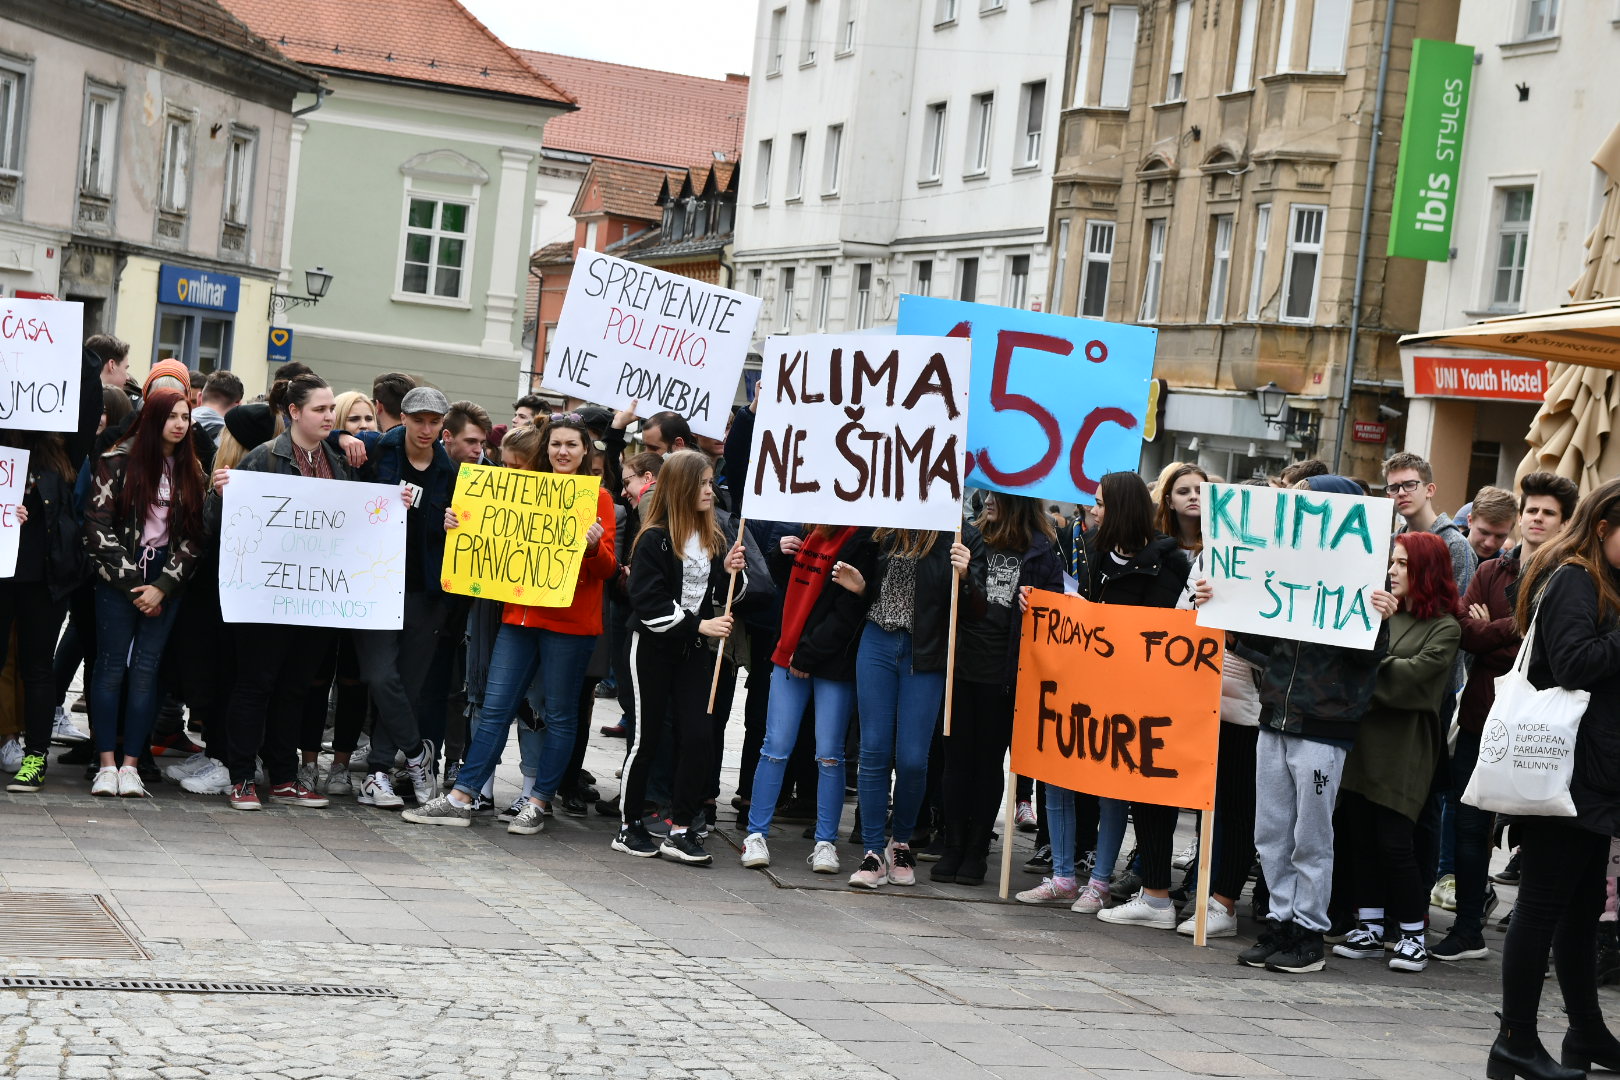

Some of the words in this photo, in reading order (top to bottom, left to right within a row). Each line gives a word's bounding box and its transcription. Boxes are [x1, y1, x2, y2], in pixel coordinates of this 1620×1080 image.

[1414, 172, 1451, 233] ibis
[187, 274, 227, 307] mlinar
[584, 257, 742, 334] SPREMENITE
[1, 309, 54, 345] ČASA
[603, 306, 708, 370] POLITIKO,
[0, 380, 67, 420] JMO!
[558, 346, 598, 388] NE
[616, 361, 711, 422] PODNEBJA
[776, 347, 962, 420] KLIMA
[1434, 367, 1458, 389] UNI
[1461, 367, 1499, 391] Youth
[1500, 368, 1543, 393] Hostel
[754, 424, 821, 496] NE
[833, 404, 962, 503] ŠTIMA
[464, 469, 577, 510] ZAHTEVAMO
[261, 495, 346, 530] ZELENO
[479, 505, 577, 548] PODNEBNO
[1209, 484, 1373, 555] KLIMA
[280, 532, 345, 559] OKOLJE
[453, 533, 578, 591] PRAVIČNOST
[1211, 545, 1255, 580] NE
[260, 561, 350, 594] ZELENA
[271, 595, 379, 618] PRIHODNOST
[1031, 606, 1115, 659] FRIDAYS
[1139, 630, 1221, 675] FOR
[1036, 680, 1179, 778] FUTURE
[1515, 734, 1566, 745] EUROPEAN
[1517, 723, 1551, 732] MODEL
[1513, 745, 1570, 758] PARLIAMENT
